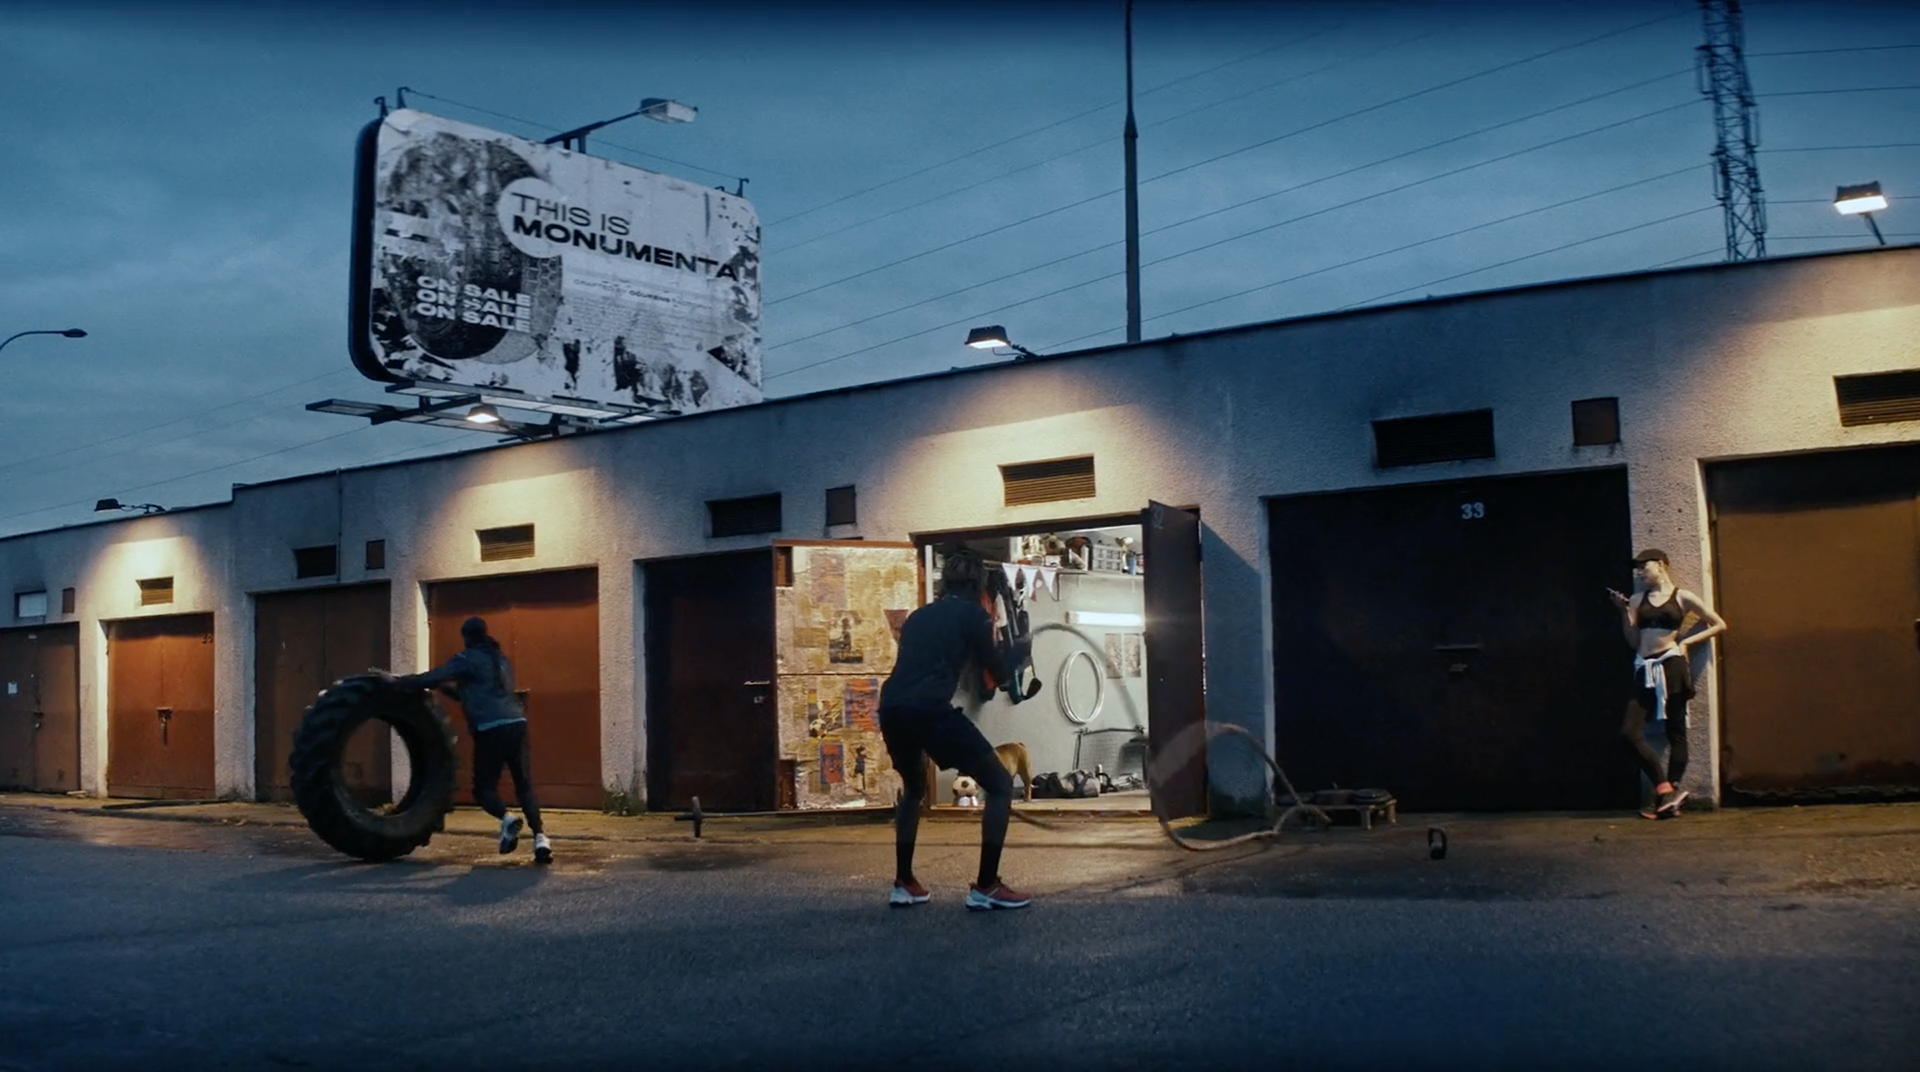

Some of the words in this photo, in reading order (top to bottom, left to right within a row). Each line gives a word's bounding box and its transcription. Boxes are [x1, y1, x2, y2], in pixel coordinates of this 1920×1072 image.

[511, 192, 591, 227] THIS
[601, 214, 630, 236] IS
[417, 276, 456, 292] ON
[464, 284, 531, 307] SALE
[417, 289, 456, 306] ON
[463, 298, 531, 320] SALE
[416, 302, 456, 320] ON
[462, 311, 531, 333] SALE
[1461, 502, 1485, 519] 33
